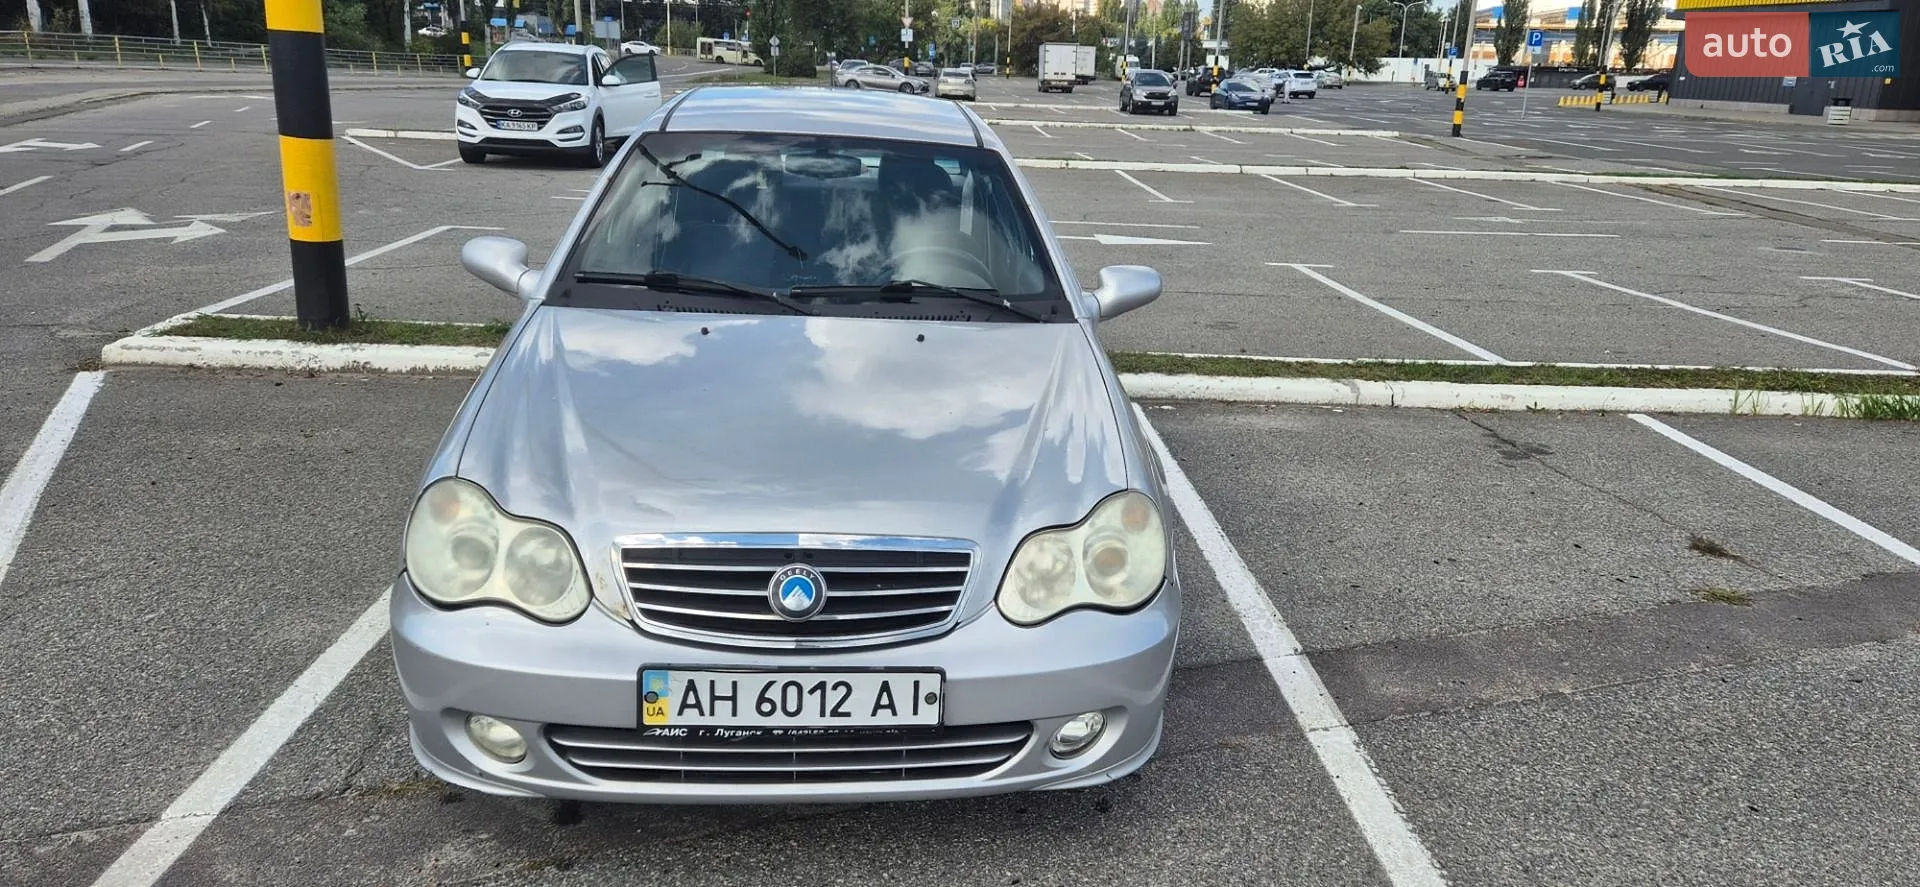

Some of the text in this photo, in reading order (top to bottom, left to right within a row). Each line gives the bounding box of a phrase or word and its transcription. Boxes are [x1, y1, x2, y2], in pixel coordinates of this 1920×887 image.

[1532, 32, 1541, 45] P
[677, 679, 738, 717] AH
[755, 680, 853, 718] 6012
[646, 707, 665, 718] UA
